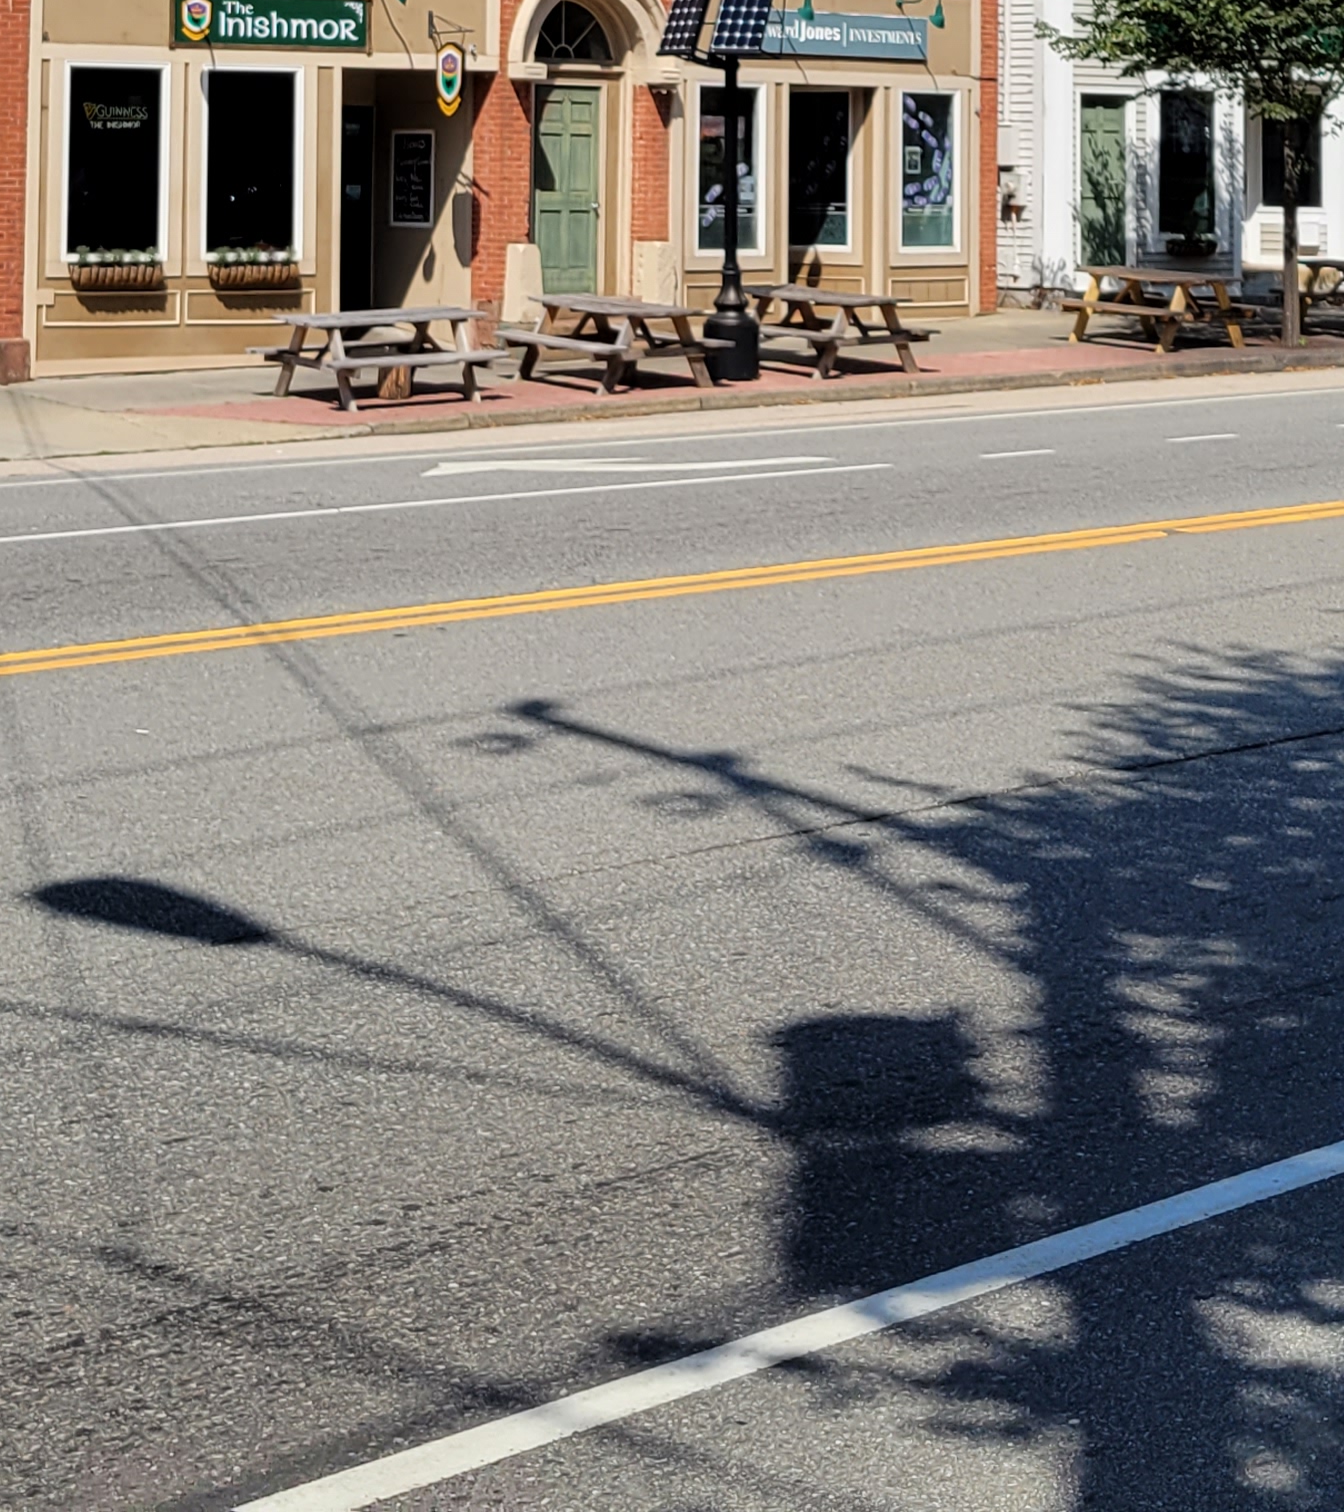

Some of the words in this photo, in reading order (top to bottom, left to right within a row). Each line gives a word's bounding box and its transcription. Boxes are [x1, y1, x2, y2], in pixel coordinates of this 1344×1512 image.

[222, 0, 254, 15] The
[849, 27, 922, 46] INVESTMENTS
[96, 104, 149, 120] GUINNESS
